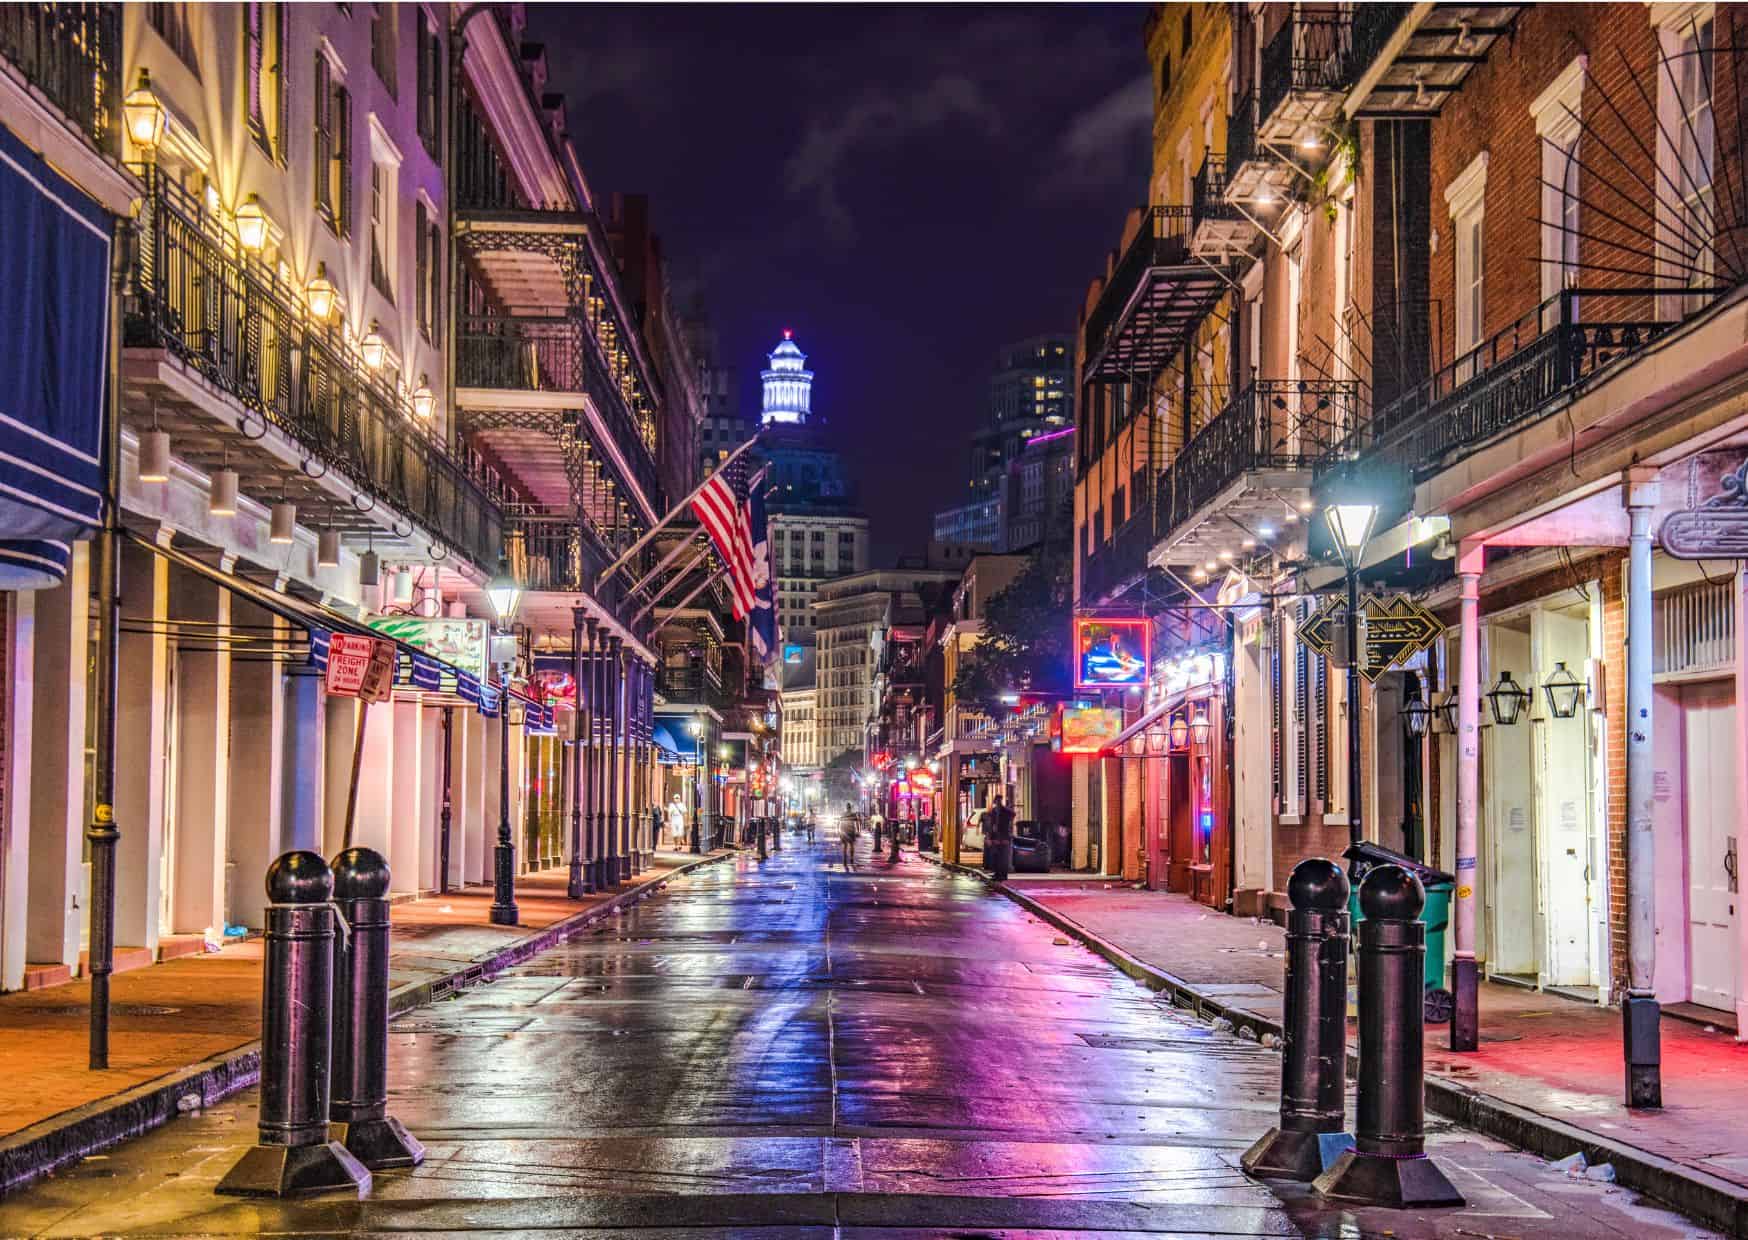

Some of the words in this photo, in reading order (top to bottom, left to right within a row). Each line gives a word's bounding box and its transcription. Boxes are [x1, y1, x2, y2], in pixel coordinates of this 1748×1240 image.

[330, 638, 343, 650] NO
[332, 655, 368, 667] FREIGHT
[337, 665, 358, 677] ZONE
